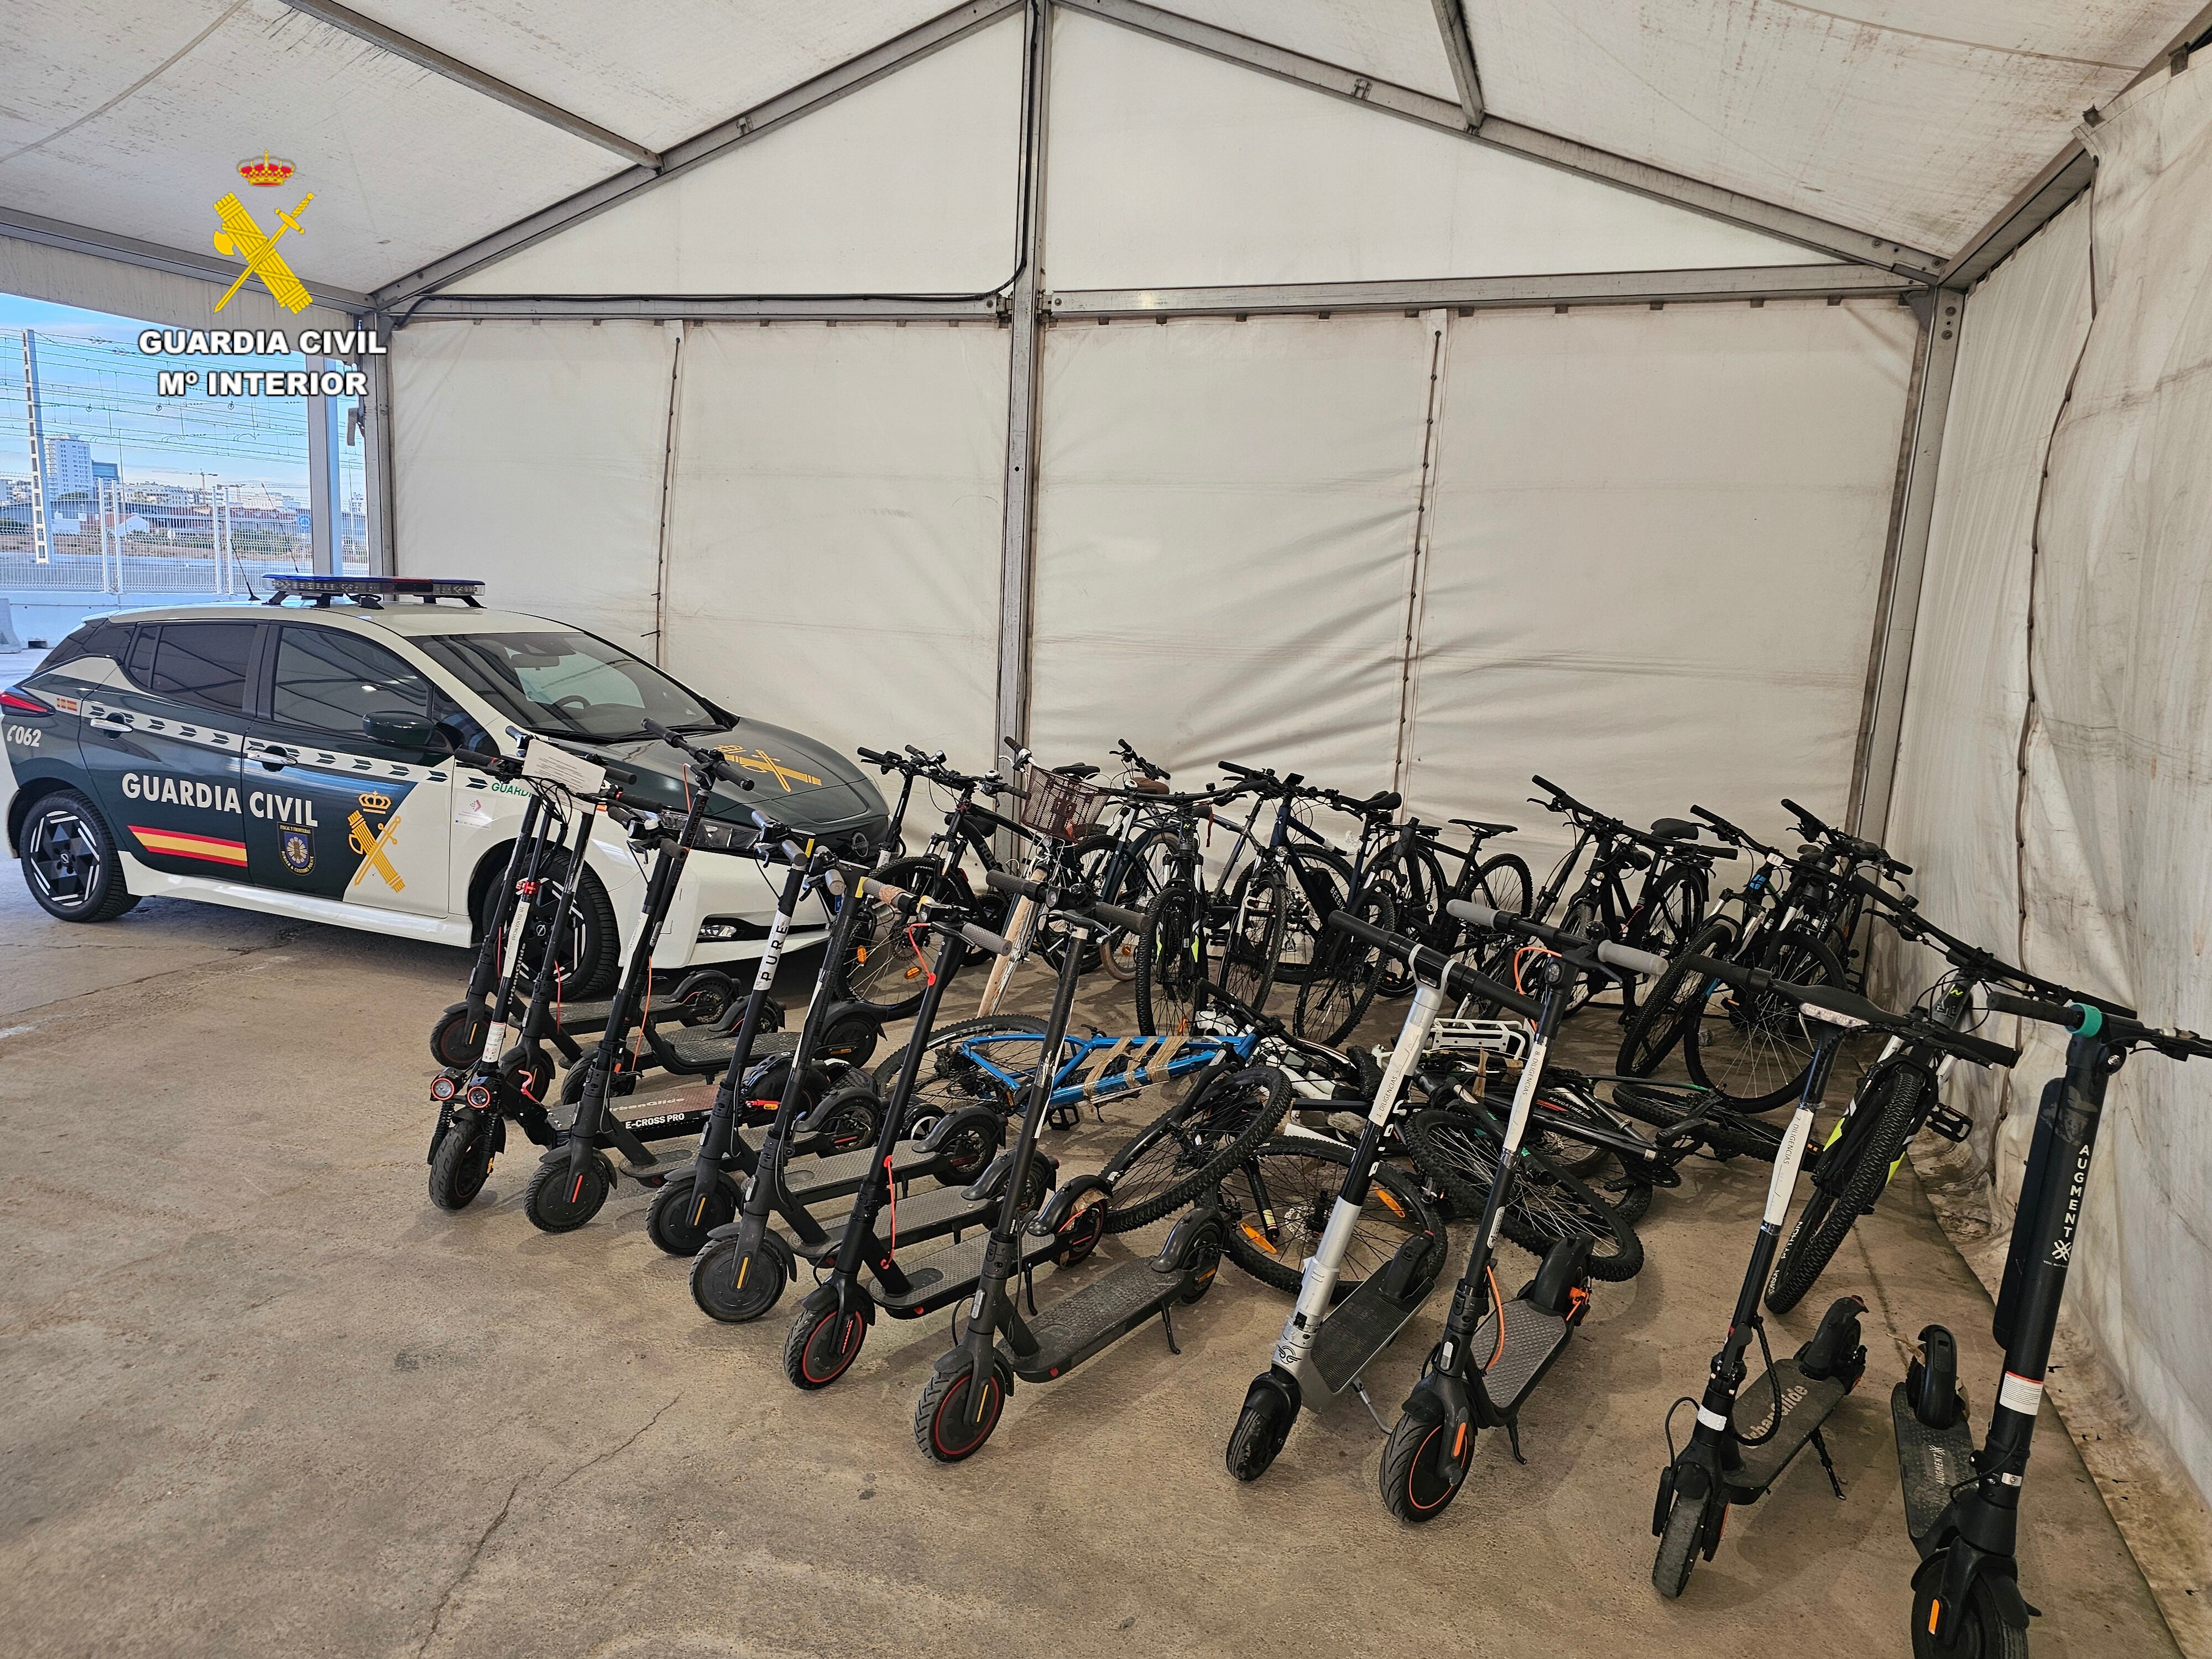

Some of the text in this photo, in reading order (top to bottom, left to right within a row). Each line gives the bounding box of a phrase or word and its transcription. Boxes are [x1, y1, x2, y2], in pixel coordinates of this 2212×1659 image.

[15, 726, 41, 747] 062
[122, 773, 318, 827] GUARDIA CIVIL
[512, 914, 523, 941] DILIGENCIAS
[761, 925, 787, 981] PURE
[508, 942, 526, 1005] UrbanGlide
[1379, 1075, 1397, 1111] DILIGENCIAS
[1522, 1058, 1538, 1095] DILIGENCIAS
[625, 1113, 685, 1129] E-CROSS PRO
[1549, 1097, 1592, 1120] KENDATIRE.COM
[1783, 1123, 1799, 1165] DILIGENCIAS
[2064, 1144, 2090, 1238] AUGMENT
[1781, 1221, 1803, 1259] PYTHON
[1933, 1453, 1946, 1486] AUGMENT
